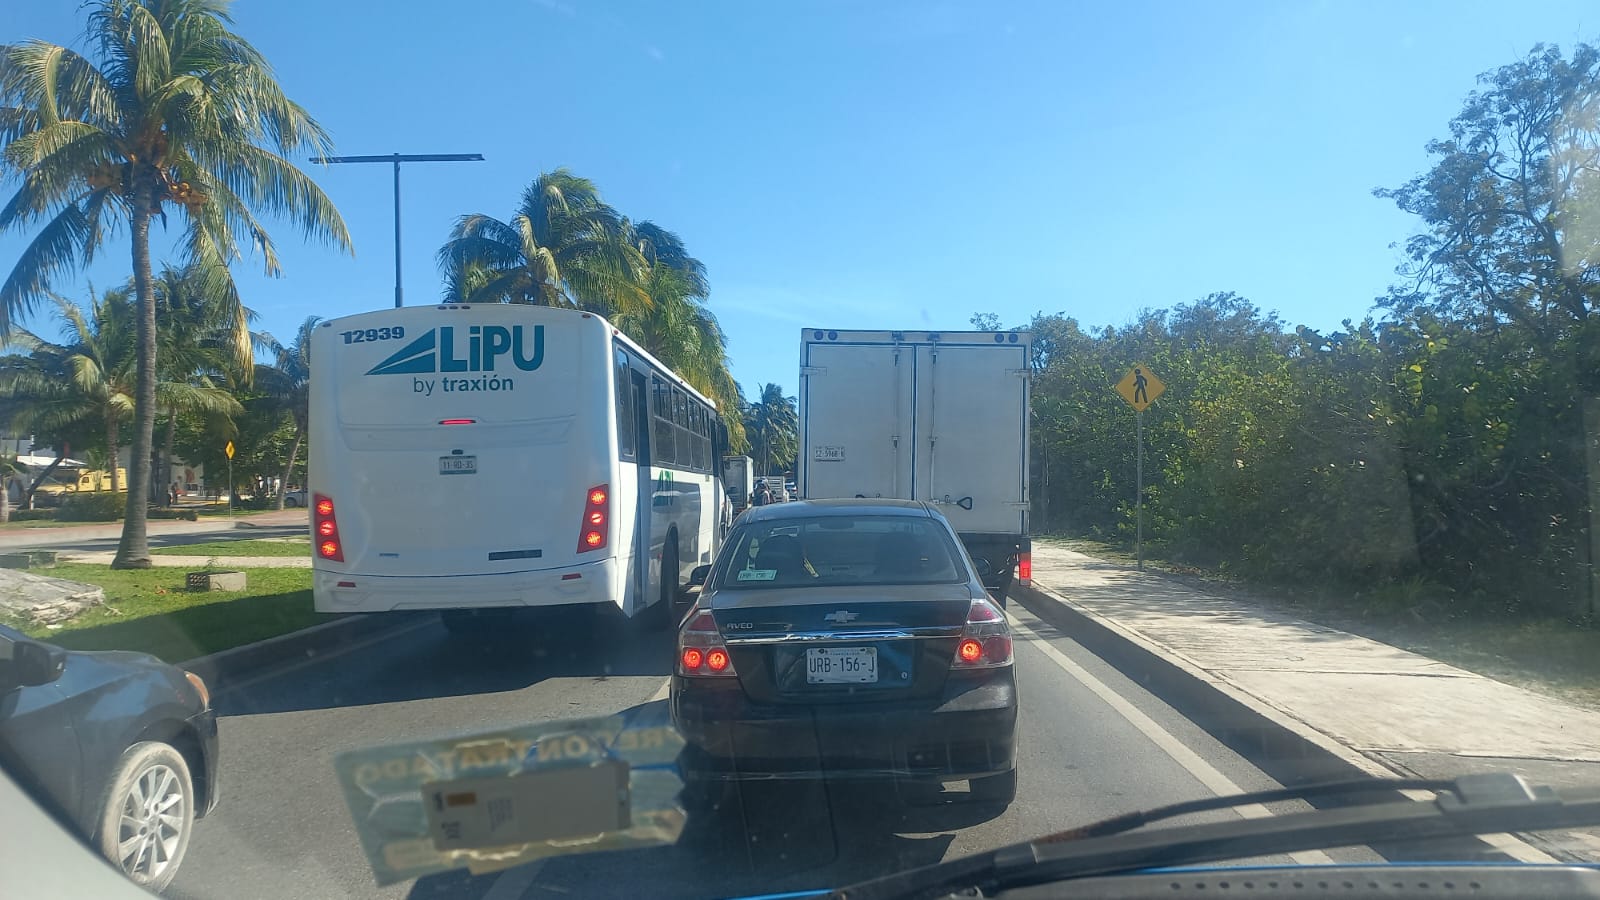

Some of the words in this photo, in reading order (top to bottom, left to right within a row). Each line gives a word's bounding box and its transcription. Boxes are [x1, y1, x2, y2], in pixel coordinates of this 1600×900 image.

[339, 326, 405, 345] 12939
[439, 324, 545, 373] LiPU
[413, 376, 436, 397] by
[442, 374, 514, 392] traxión
[726, 622, 754, 630] AVEO
[809, 656, 875, 674] URB-156-J
